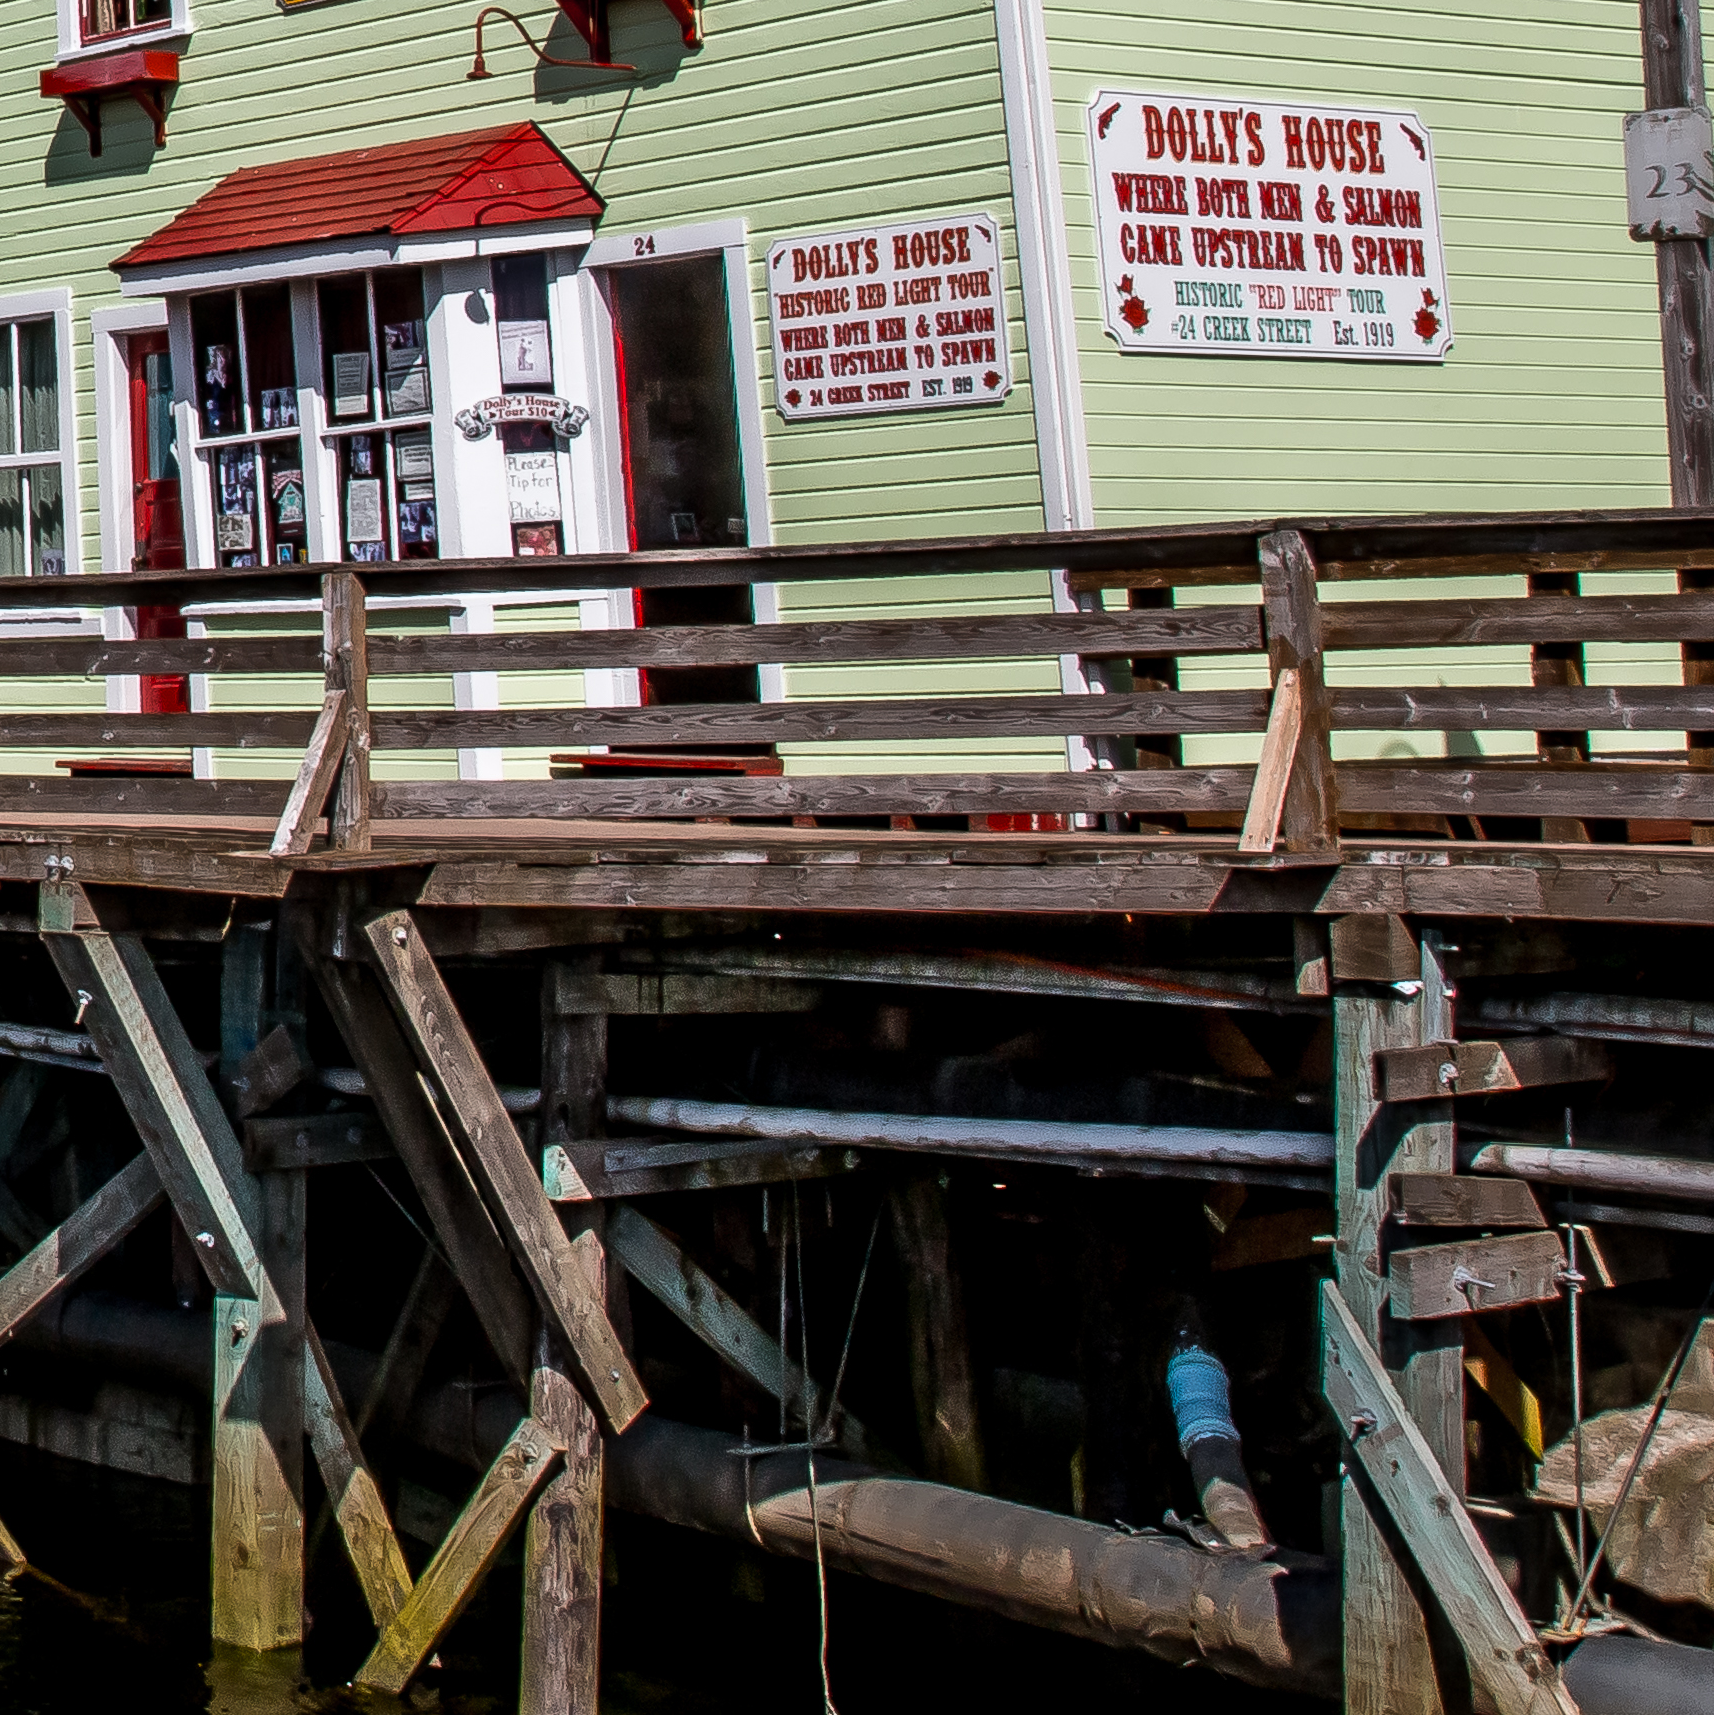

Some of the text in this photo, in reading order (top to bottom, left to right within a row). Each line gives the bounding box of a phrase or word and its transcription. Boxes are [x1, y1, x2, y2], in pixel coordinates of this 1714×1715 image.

[1142, 104, 1385, 175] DOLLY'S HOUSE
[1643, 162, 1697, 198] 23
[1111, 172, 1423, 229] WHERE BOTH MEN & SALMON
[633, 234, 656, 256] 24
[791, 226, 972, 283] DOLLY'S HOUSE
[1120, 222, 1426, 278] CAME UPSTREAM TO SPAWN
[773, 267, 994, 320] "HISTORIC RED LIGHT TOUR"
[1173, 280, 1386, 314] HISTORIC "RED LIGHT" TOUR
[779, 307, 996, 353] WHERE BOTH MEN & SALMON
[1171, 314, 1395, 347] #24 CREEK STREET Est. 1919
[783, 337, 997, 382] CAME UPSTREAM TO SPAWN
[483, 395, 560, 411] Dolly's House
[809, 375, 973, 407] 24 CREEK STREET EST. 1919
[496, 406, 548, 419] Tour $10
